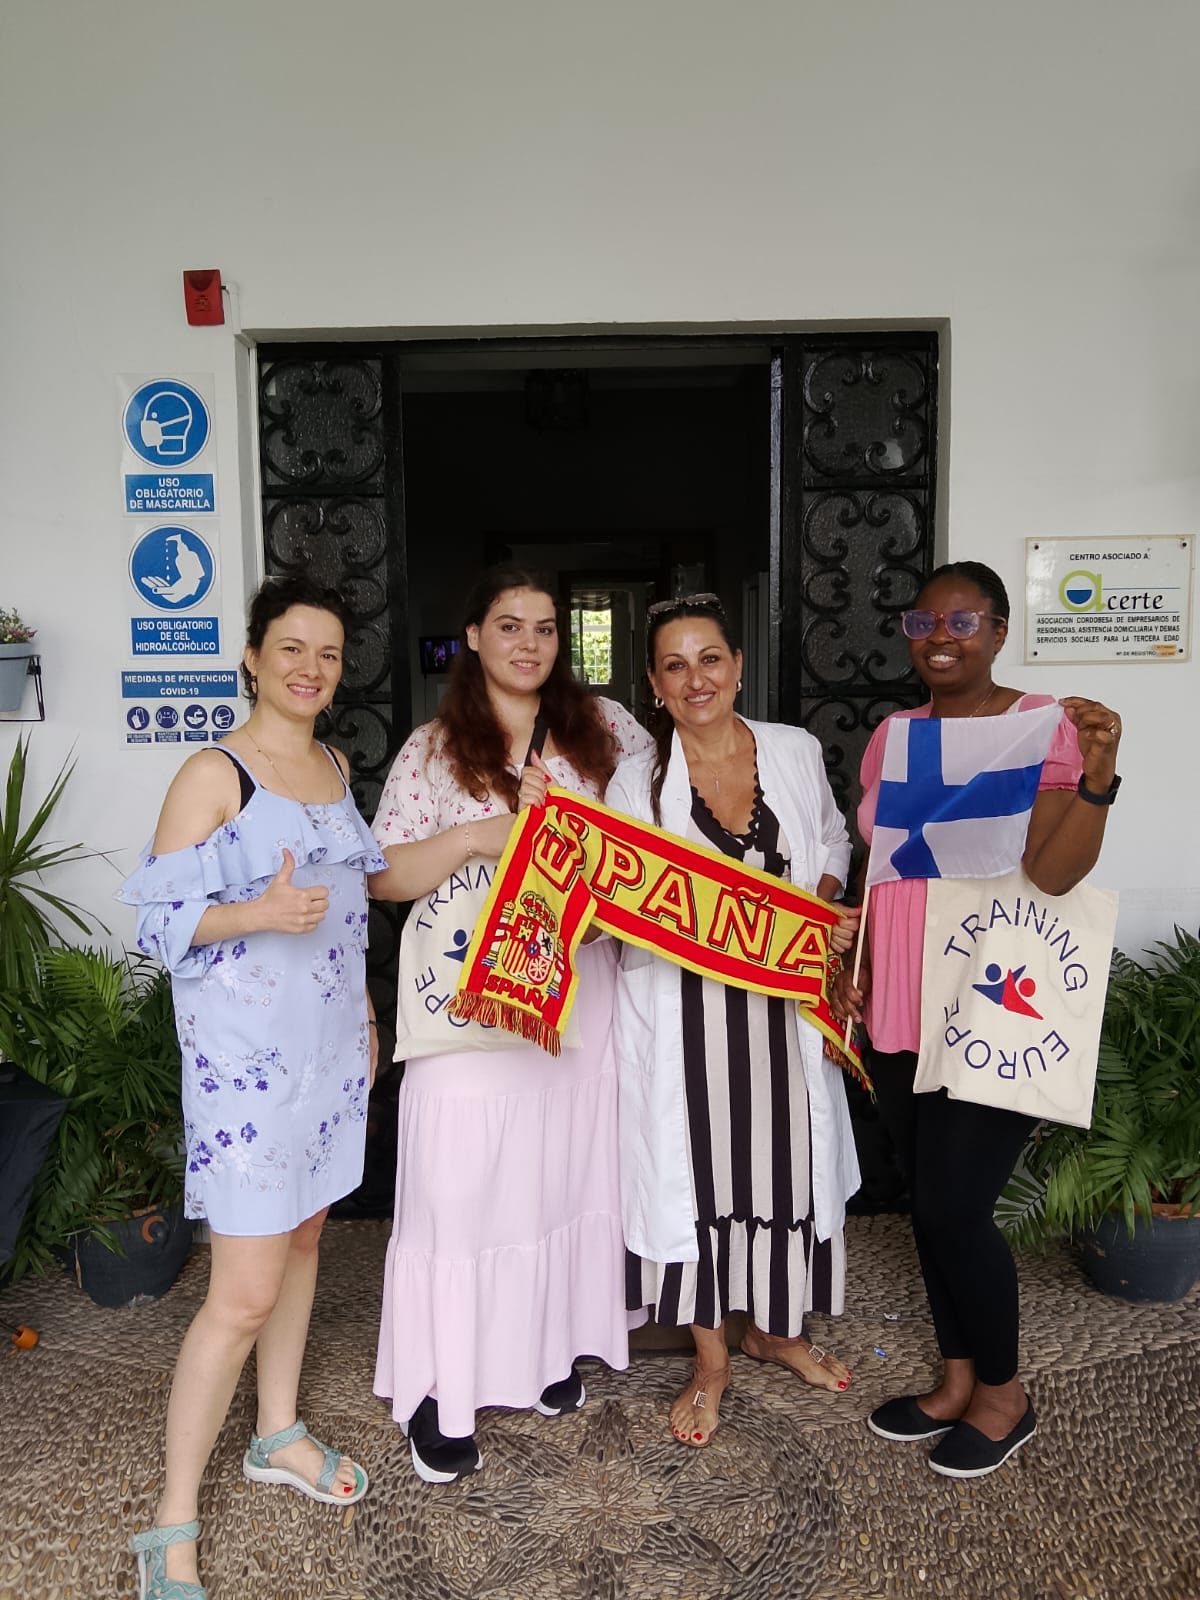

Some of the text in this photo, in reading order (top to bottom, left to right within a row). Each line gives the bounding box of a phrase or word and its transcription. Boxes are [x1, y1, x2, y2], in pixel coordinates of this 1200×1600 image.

[158, 477, 180, 487] USO
[135, 488, 204, 499] OBLIGATORIO
[129, 499, 211, 509] DE MASCARILLA
[1069, 553, 1101, 561] CENTRO
[1102, 552, 1142, 560] ASOCIADO
[1076, 616, 1113, 624] CORDOBESA
[1127, 615, 1170, 623] EMPRESARIOS
[137, 620, 213, 631] USO OBLIGATORIO
[1078, 625, 1113, 633] ASISTENCIA
[1113, 625, 1153, 633] DOMICILIARIA
[160, 631, 191, 641] DE GEL
[1036, 636, 1068, 644] SERVICIOS
[1071, 635, 1100, 643] SOCIALES
[1133, 634, 1160, 642] TERCERA
[135, 640, 217, 652] HIDROALCOHÓLICO
[124, 674, 163, 683] MEDIDAS
[164, 674, 177, 683] DE
[160, 687, 200, 696] COVID-19
[943, 897, 1089, 993] TRAINING
[943, 996, 1070, 1080] EUROPE
